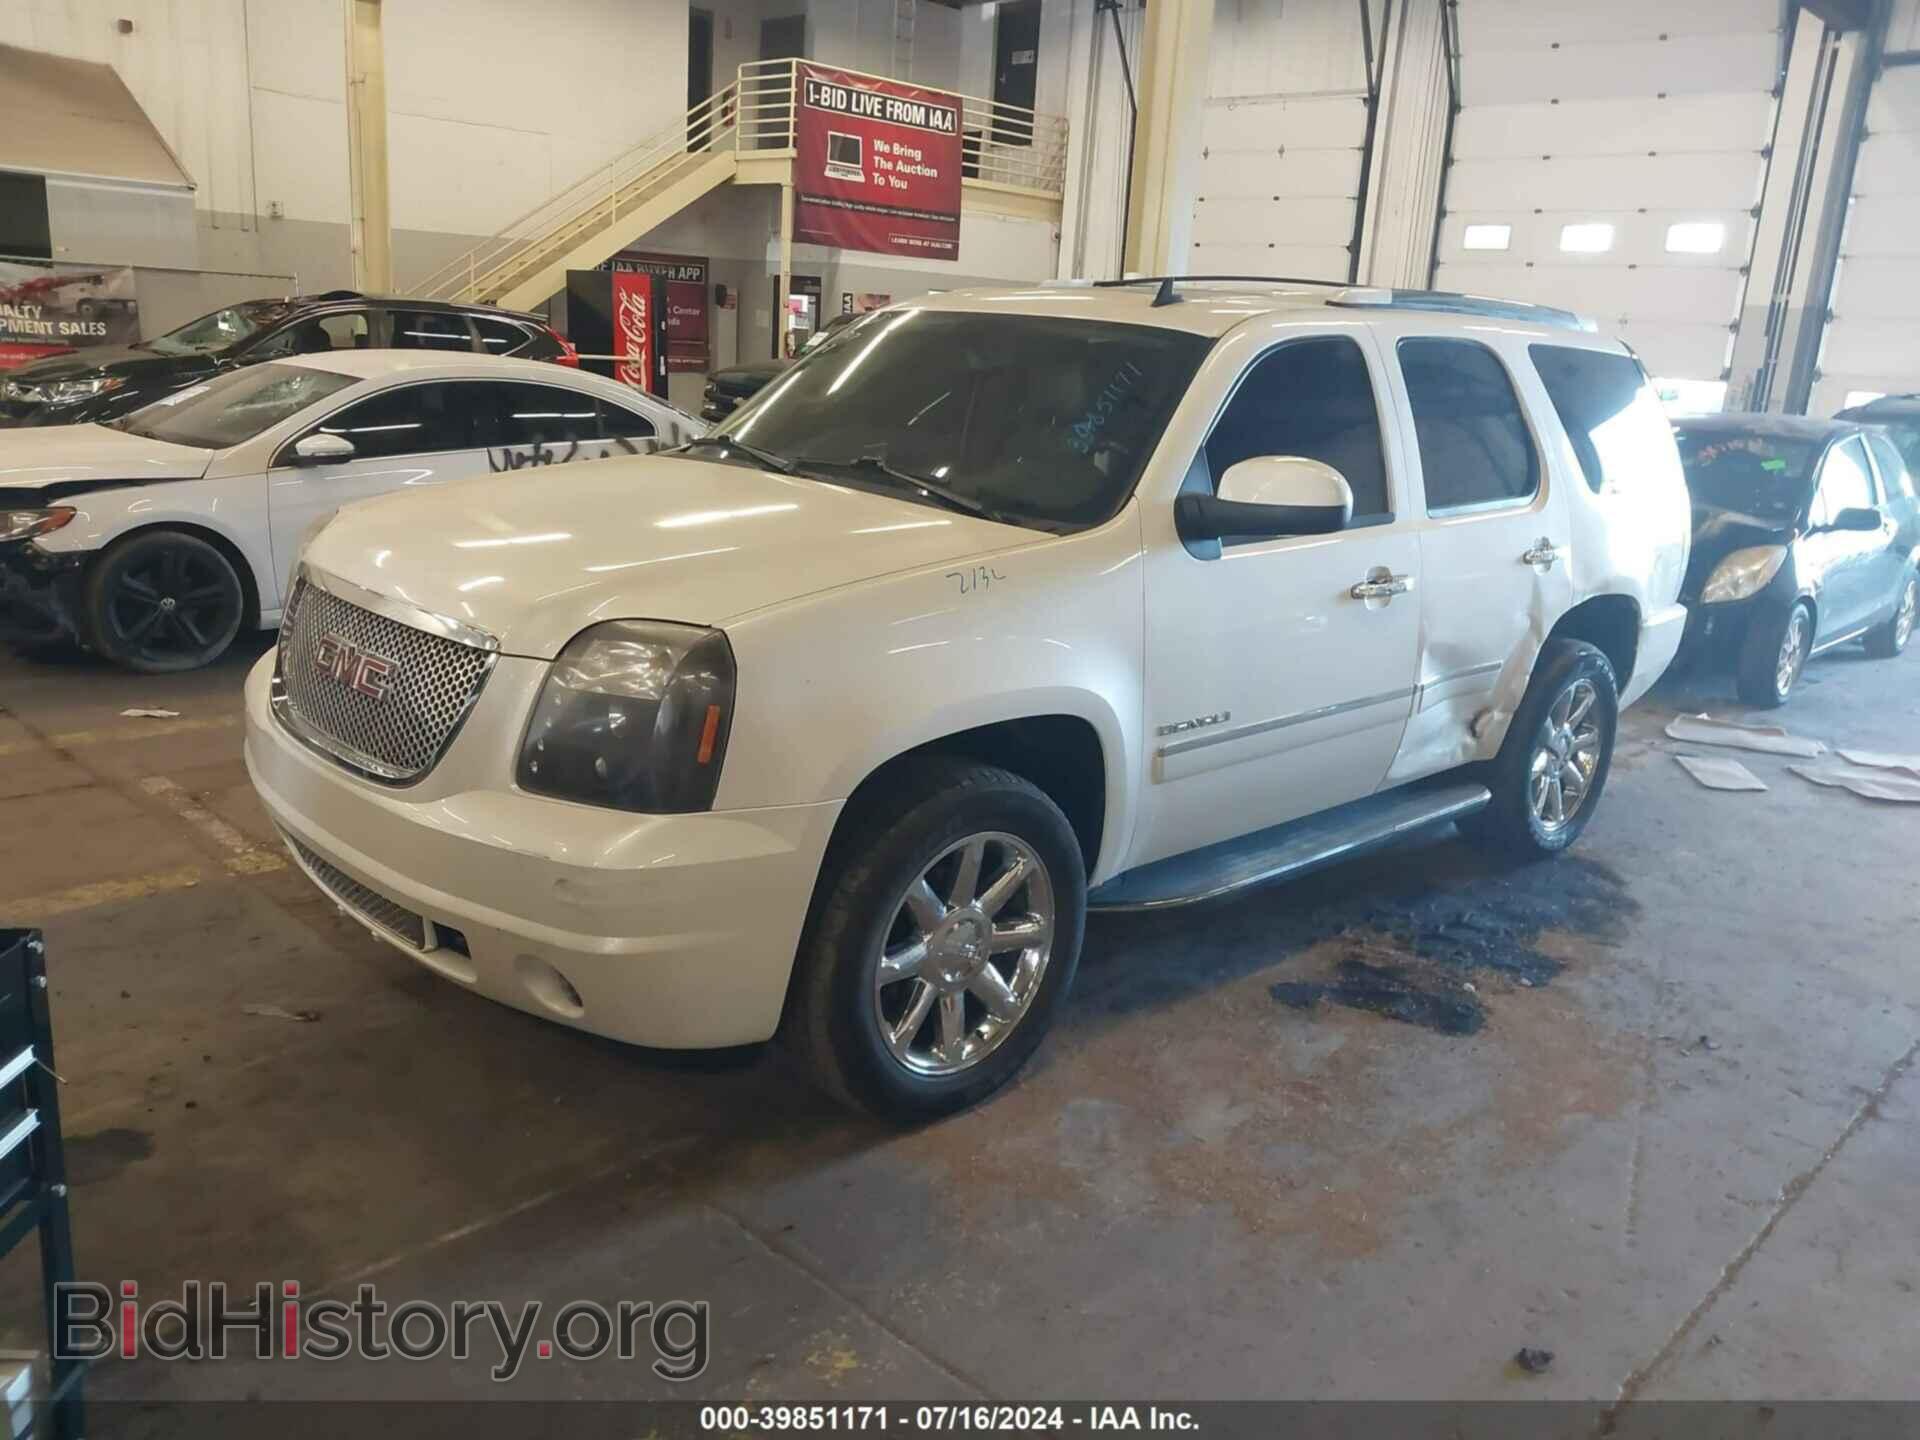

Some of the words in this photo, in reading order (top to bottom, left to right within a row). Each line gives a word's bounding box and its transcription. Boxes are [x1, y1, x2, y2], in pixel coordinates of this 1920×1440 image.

[809, 83, 847, 110] I-BID
[851, 92, 882, 118] LIVE
[886, 98, 925, 126] FROM
[928, 109, 953, 131] IAA
[873, 139, 890, 154] We
[893, 143, 922, 162] Bring
[873, 155, 894, 170] The
[896, 159, 938, 178] Auction
[872, 172, 885, 186] To
[888, 175, 908, 190] You
[678, 266, 700, 281] APP
[58, 321, 107, 336] SALES
[316, 634, 391, 701] GMC
